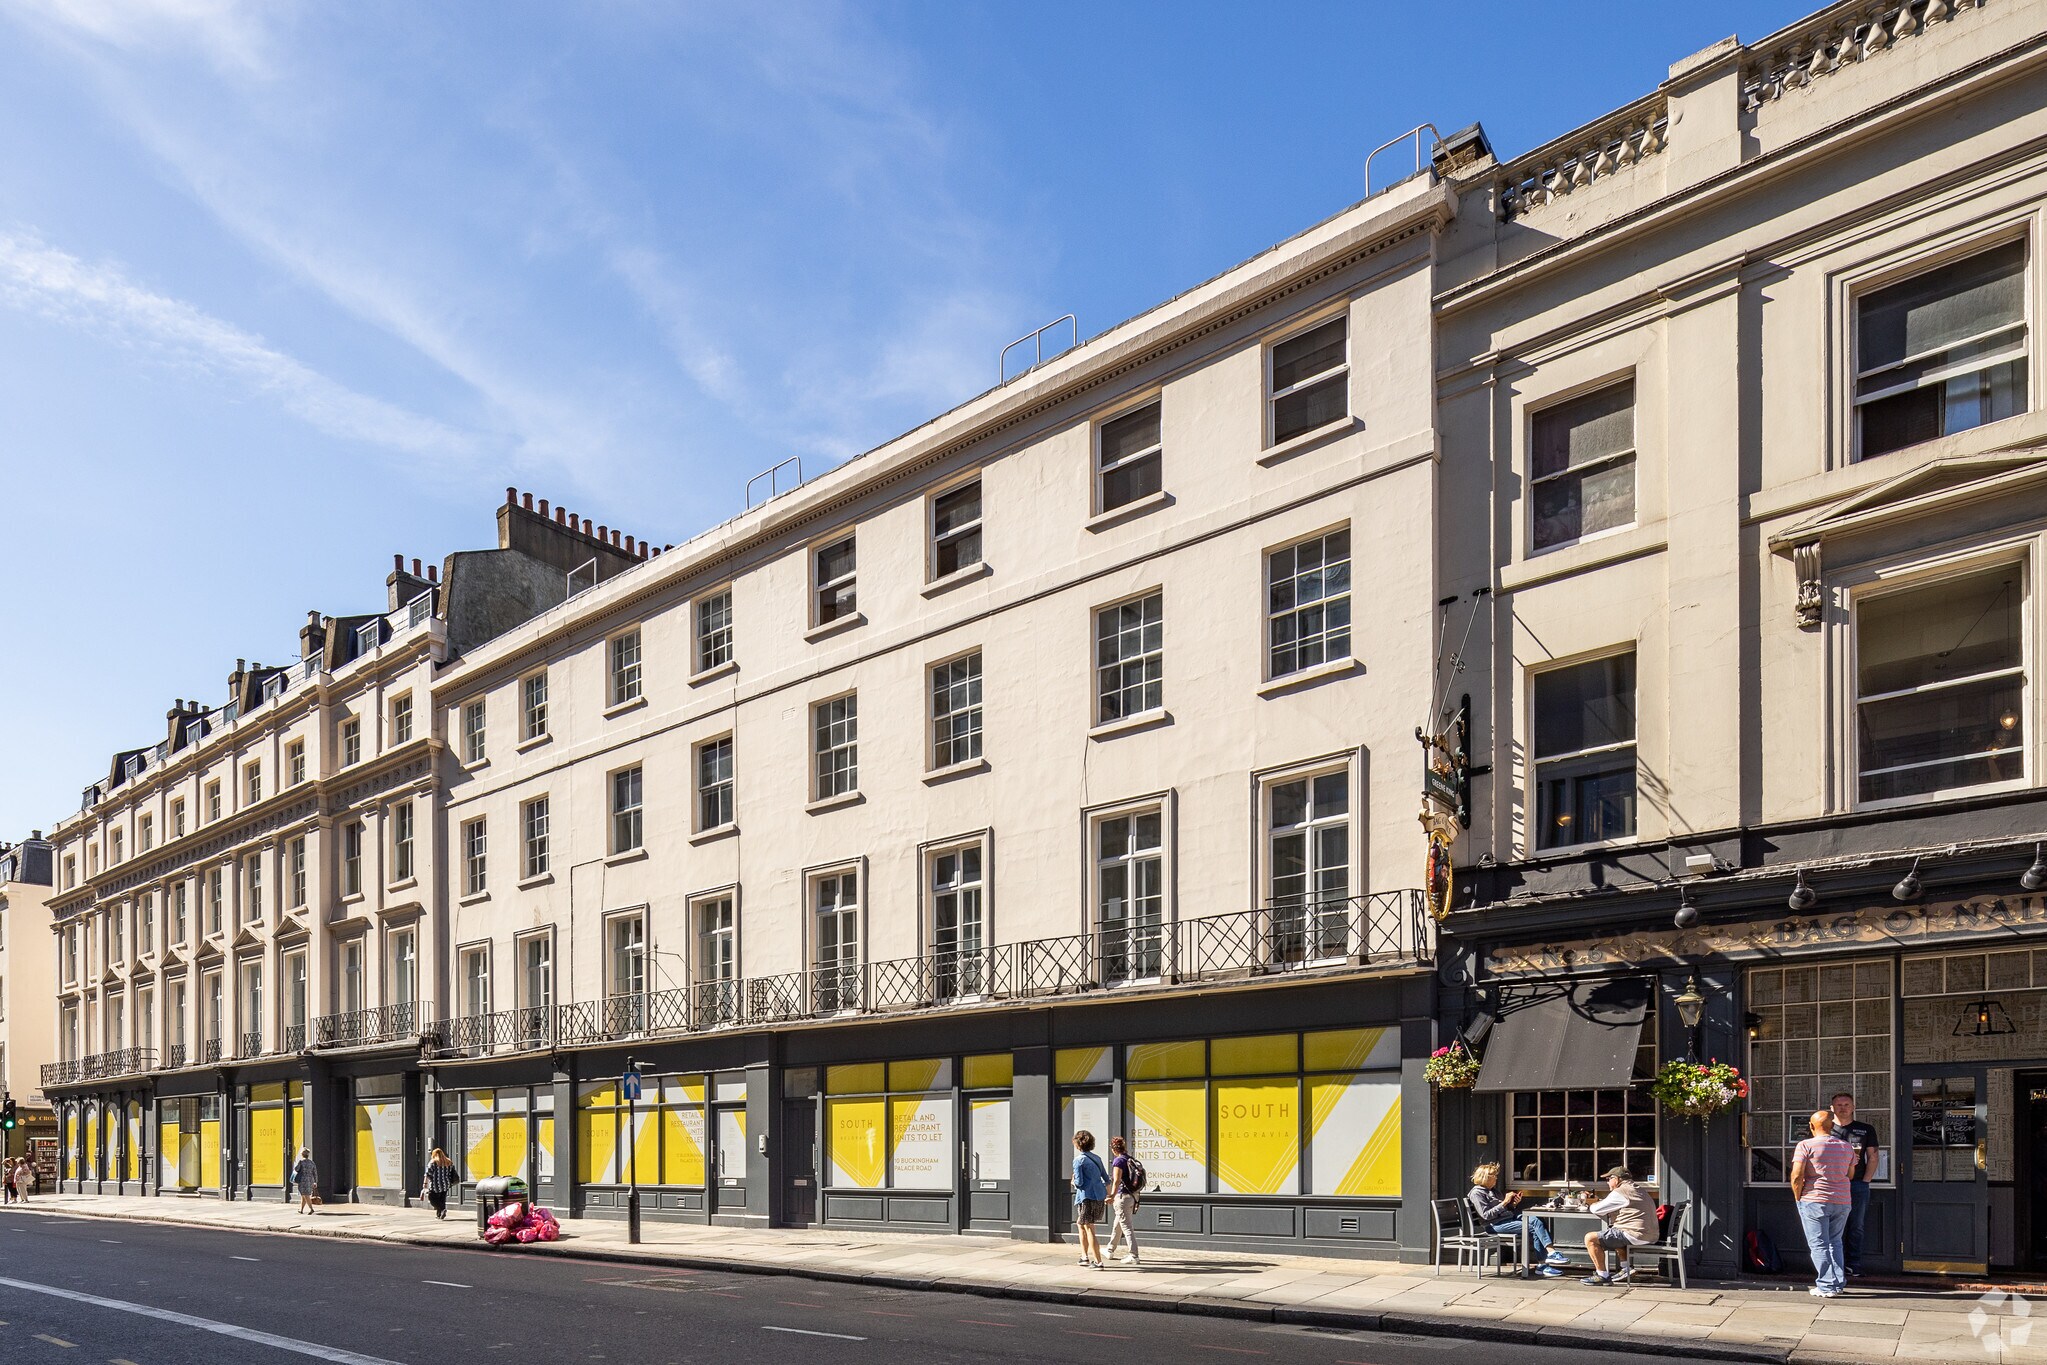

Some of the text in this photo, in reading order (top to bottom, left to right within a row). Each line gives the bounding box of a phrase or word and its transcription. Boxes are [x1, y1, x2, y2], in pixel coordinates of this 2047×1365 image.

[1431, 778, 1455, 798] GREENE KING
[1774, 915, 1859, 944] BAG
[1587, 943, 1603, 962] 6
[1220, 1103, 1289, 1120] SOUTH
[894, 1113, 936, 1122] RETAIL AND
[670, 1120, 704, 1128] RESTAURANT
[840, 1119, 873, 1129] SOUTH
[894, 1123, 941, 1131] RESTAURANT
[259, 1128, 277, 1137] SOUTH
[502, 1132, 523, 1140] SOUTH
[586, 1129, 609, 1138] SOUTH
[894, 1133, 943, 1141] UNITS TO LET
[1131, 1128, 1172, 1137] RETAIL &
[1220, 1131, 1290, 1139] BELGRAVIA
[1131, 1139, 1195, 1149] RESTAURANT
[1131, 1151, 1197, 1160] UNITS TO LET
[1160, 1180, 1182, 1188] ROAD
